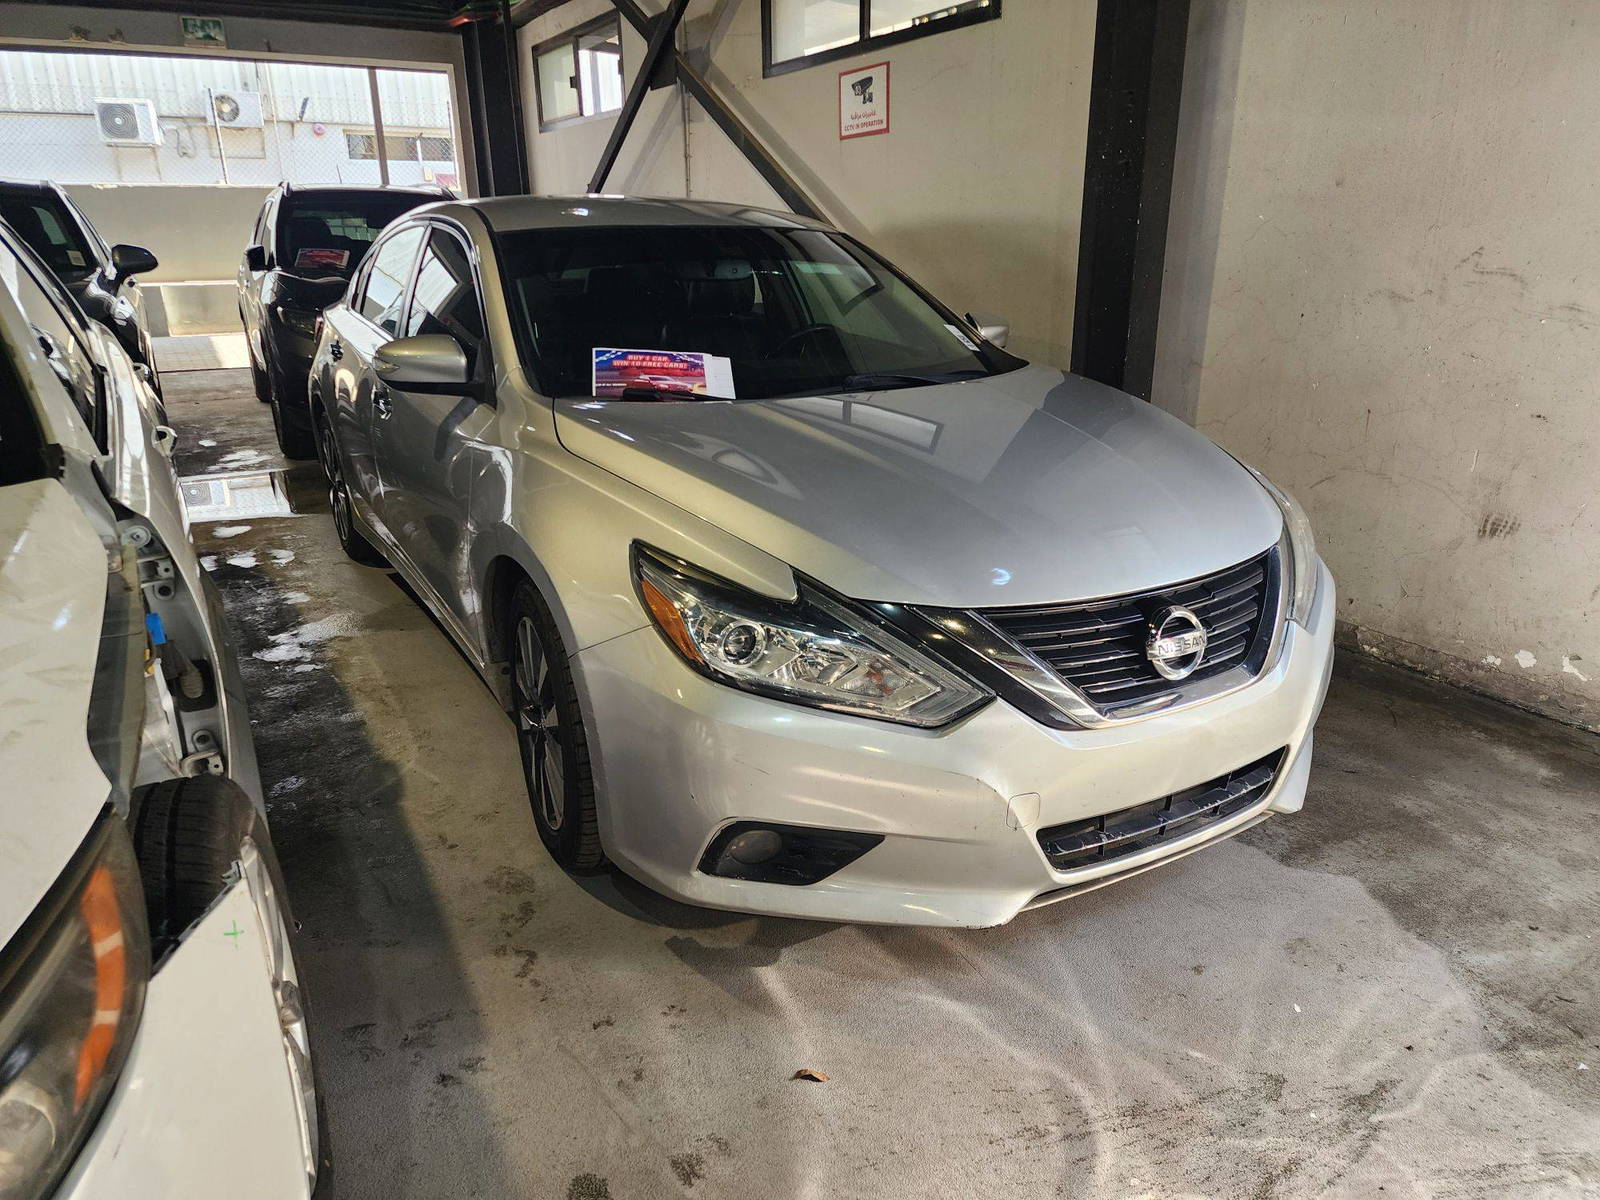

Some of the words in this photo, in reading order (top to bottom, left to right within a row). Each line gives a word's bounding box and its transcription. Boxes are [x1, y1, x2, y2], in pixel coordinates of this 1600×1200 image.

[844, 123, 854, 131] CCTV
[861, 119, 883, 128] OPERATION
[1158, 635, 1205, 655] NISSAN
